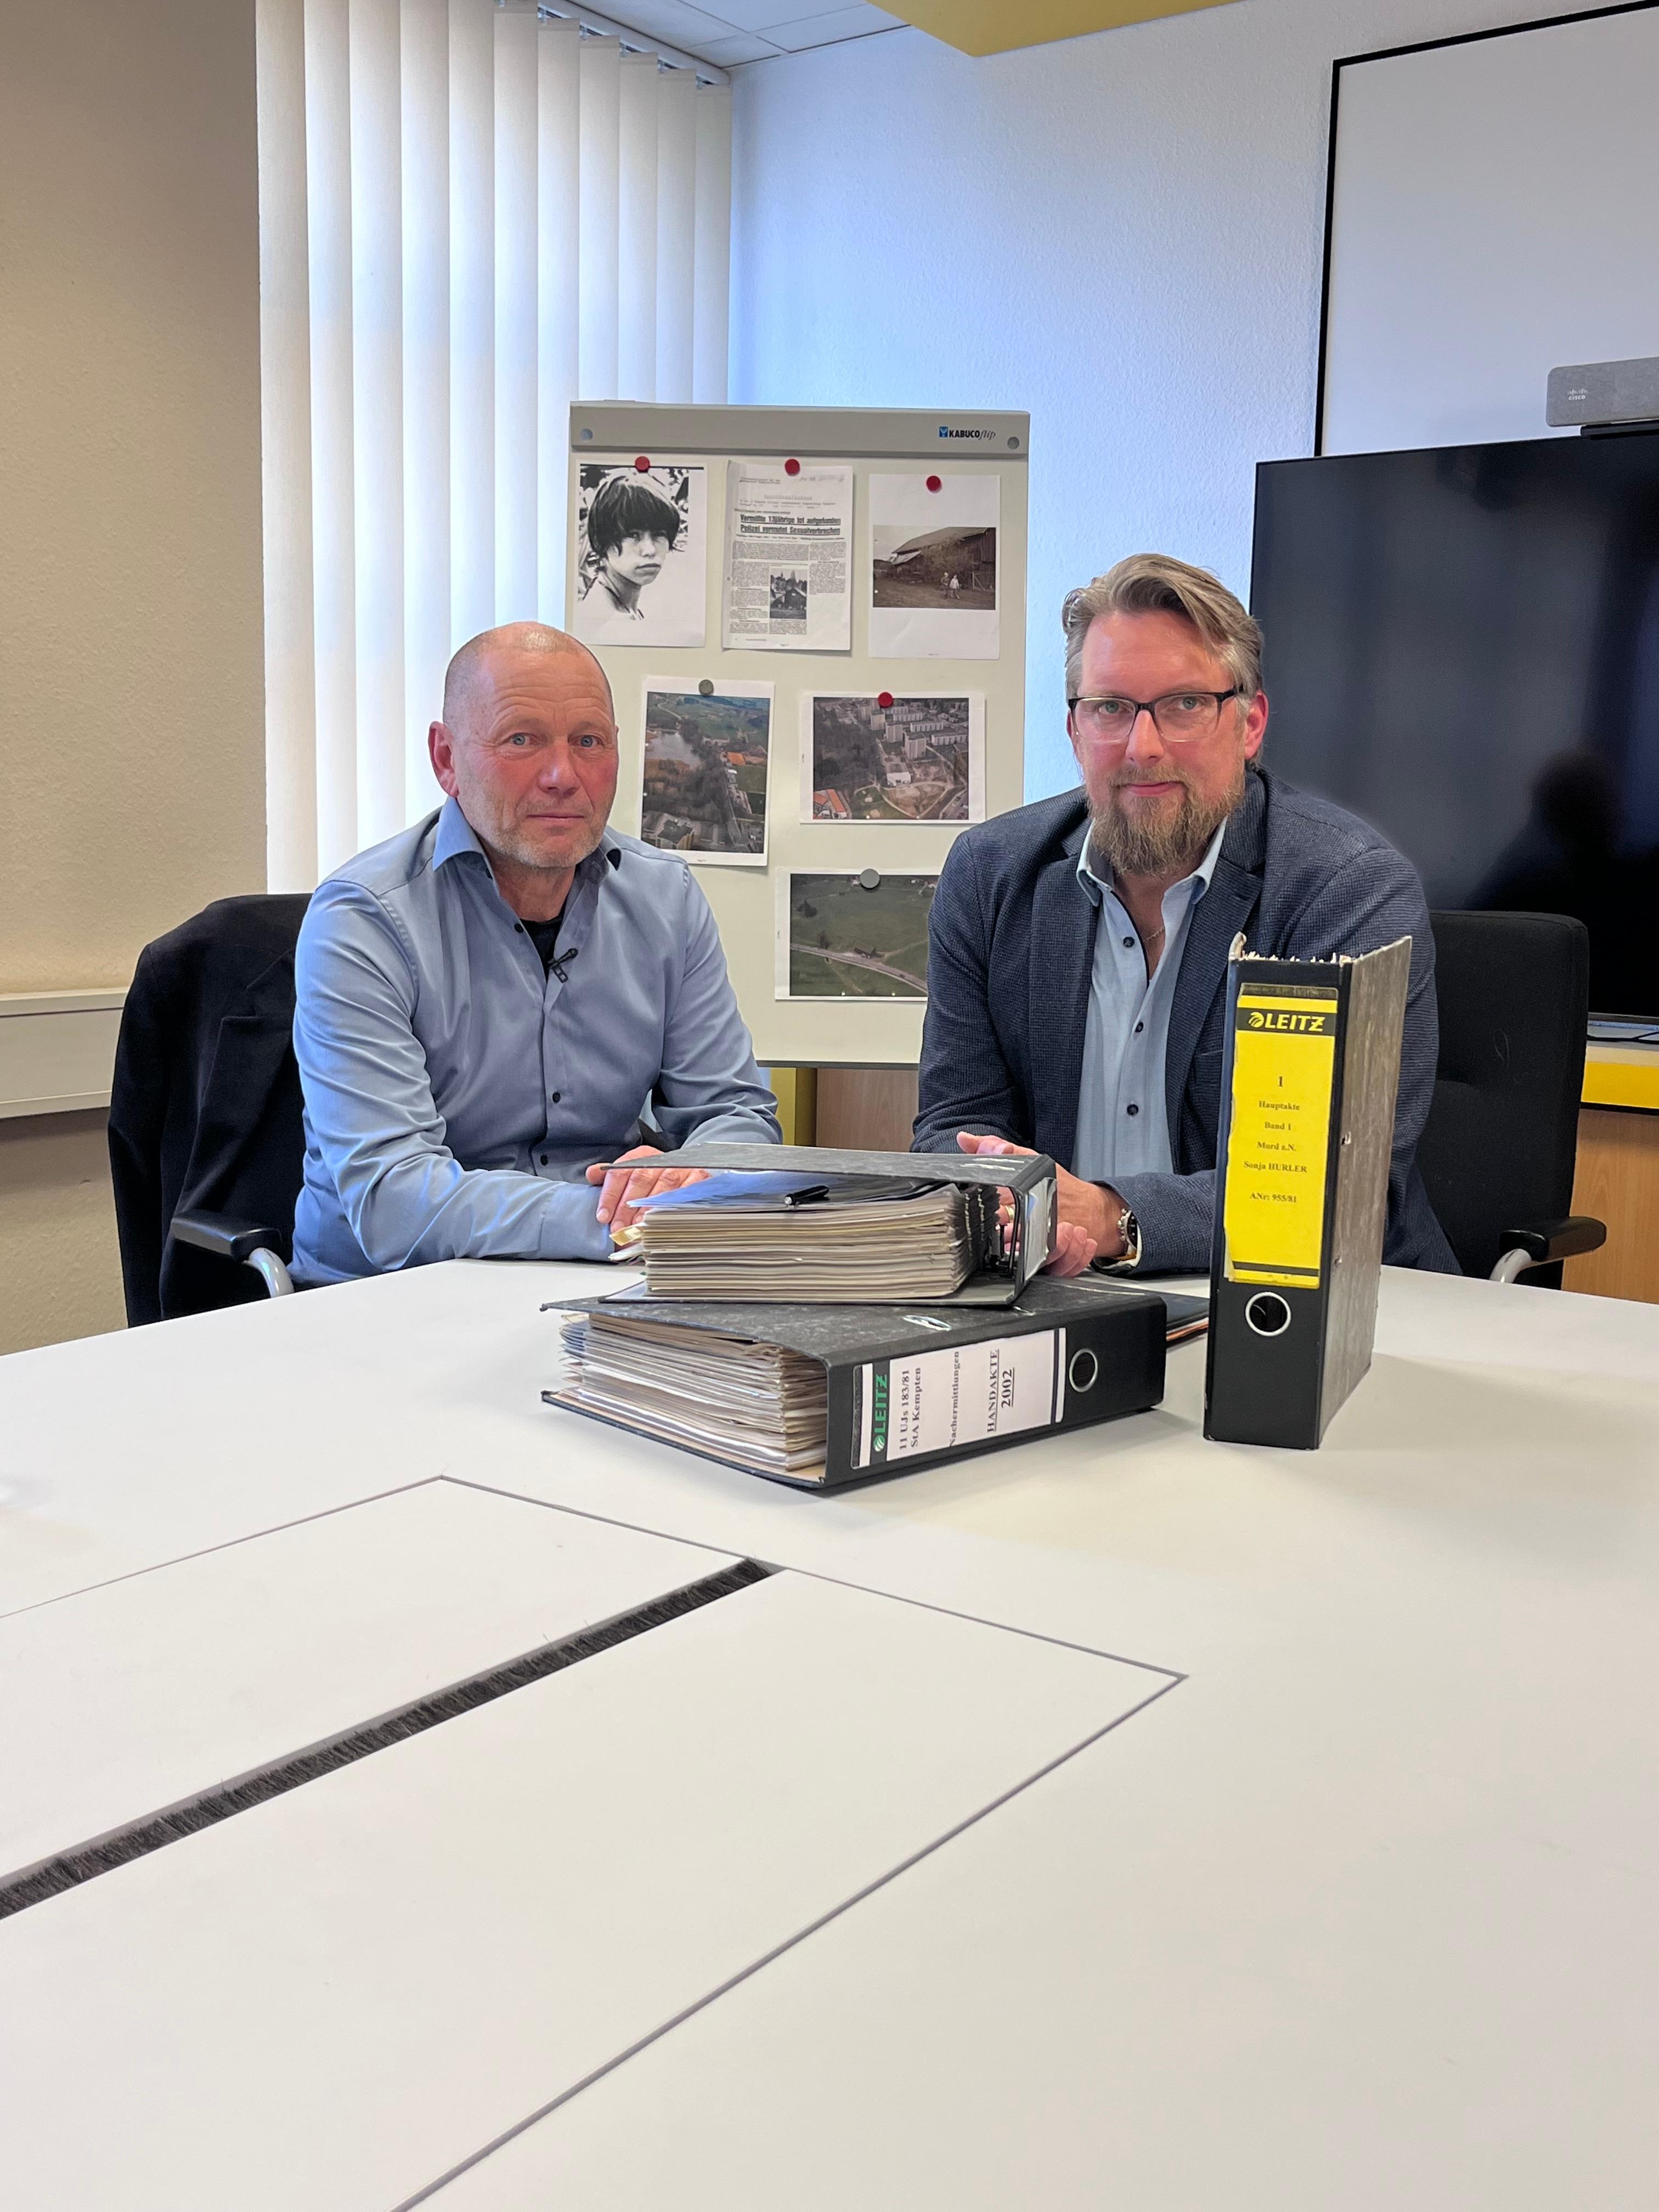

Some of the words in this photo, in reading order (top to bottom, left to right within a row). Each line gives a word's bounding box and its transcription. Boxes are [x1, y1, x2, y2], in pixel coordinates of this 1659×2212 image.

[1265, 1013, 1325, 1032] LEITZ
[1259, 1101, 1300, 1110] Hauptakte
[1265, 1122, 1285, 1130] Band
[1257, 1142, 1279, 1150] Mord
[1244, 1161, 1266, 1170] Sonja
[1268, 1163, 1307, 1172] HURLER
[1272, 1194, 1297, 1203] 955/81
[901, 1370, 910, 1406] 183/81
[912, 1368, 922, 1421] Kempten
[988, 1349, 998, 1431] HANDAKTE
[1001, 1369, 1012, 1409] 2002
[874, 1374, 887, 1433] LEITZ
[900, 1438, 907, 1449] 11
[911, 1425, 919, 1447] StA
